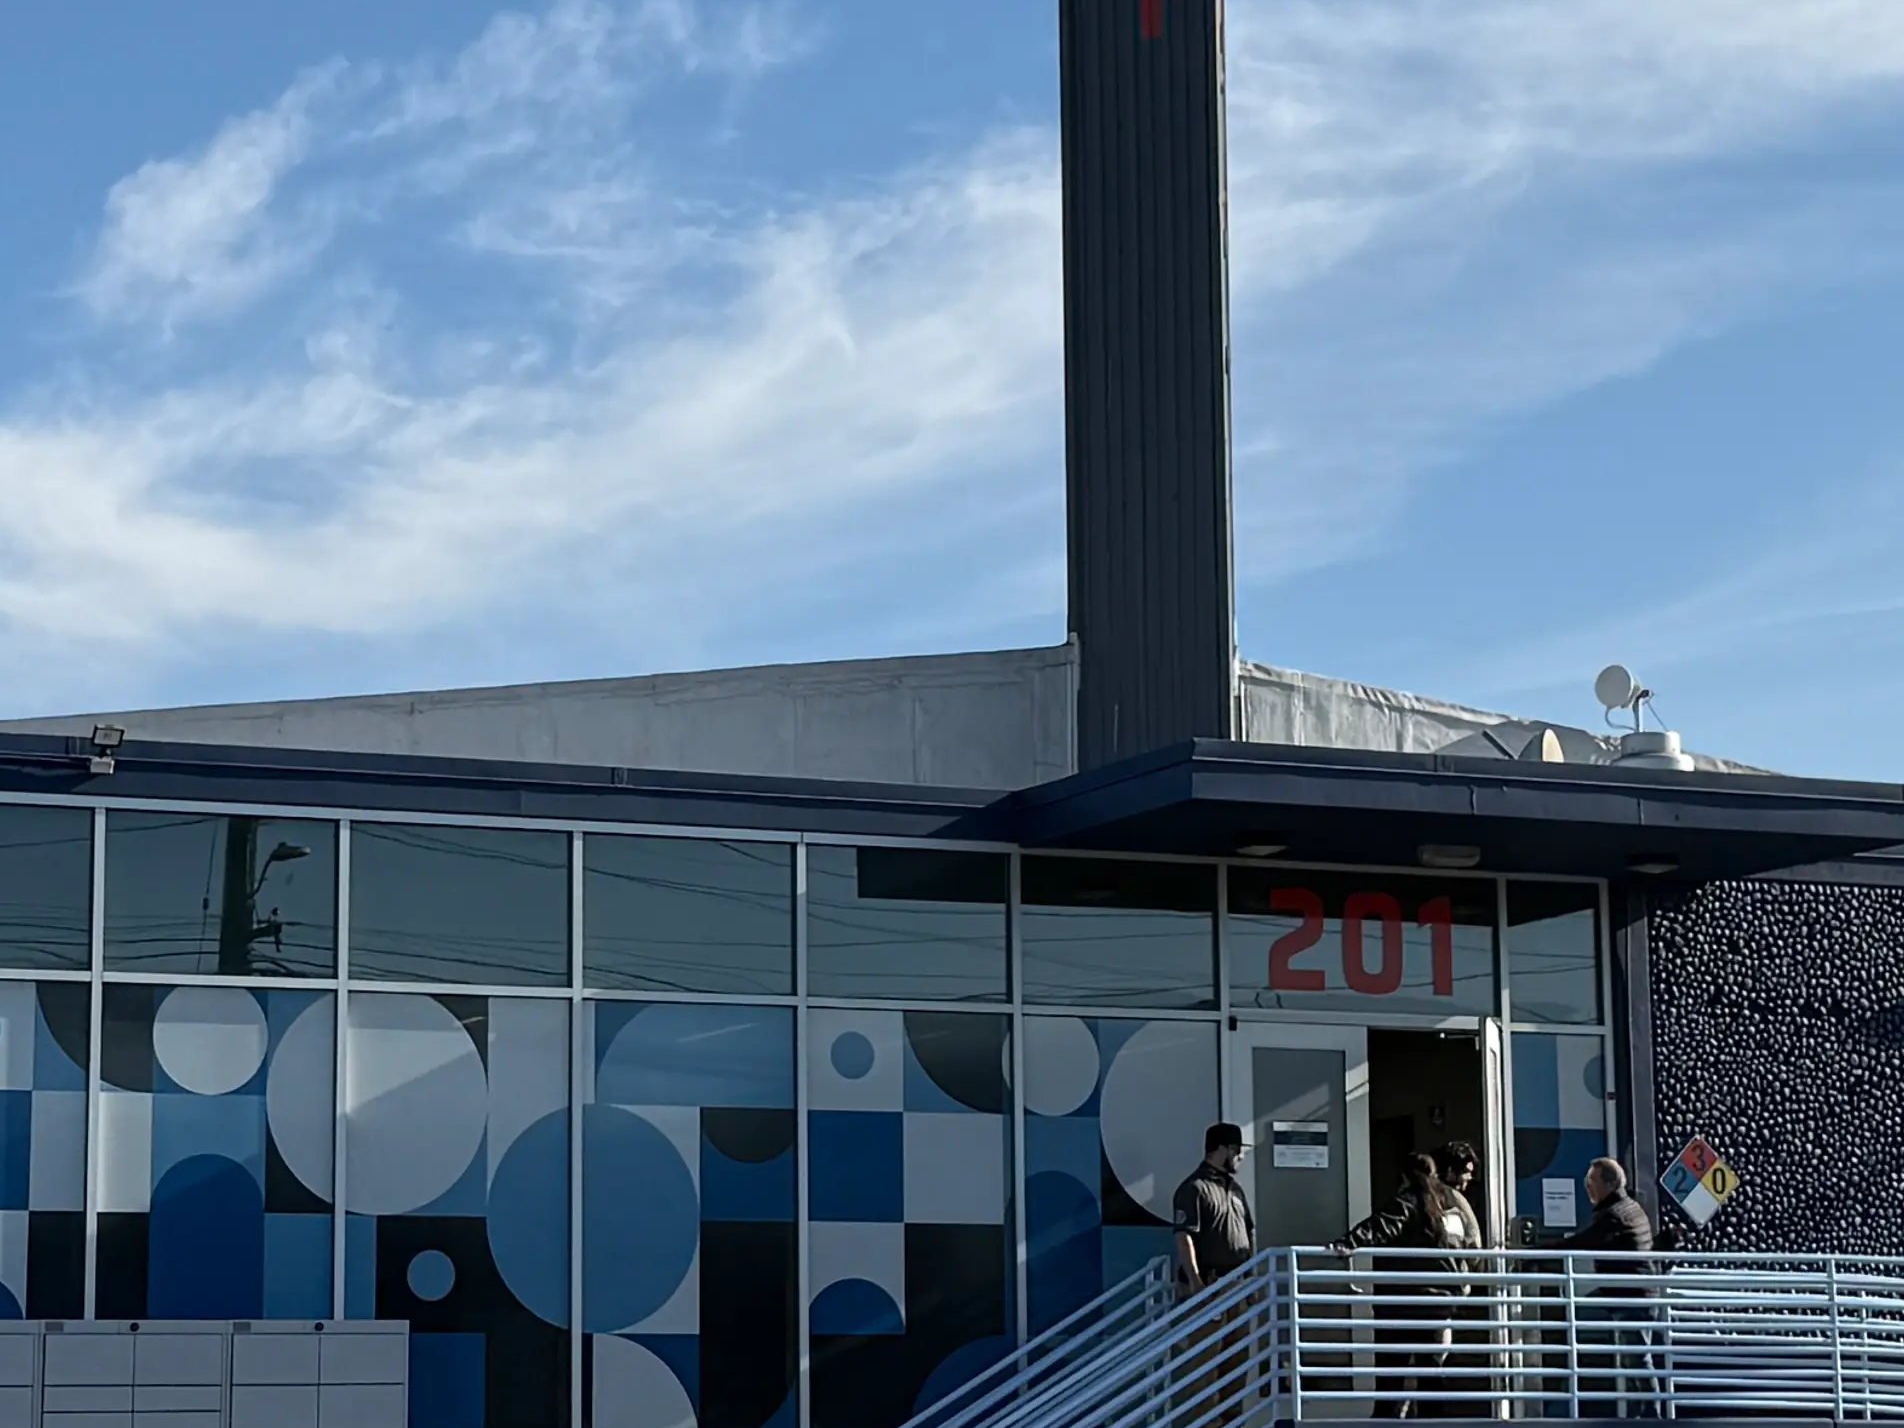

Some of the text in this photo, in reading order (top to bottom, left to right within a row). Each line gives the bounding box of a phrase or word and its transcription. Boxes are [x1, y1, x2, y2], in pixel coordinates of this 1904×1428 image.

[1269, 886, 1453, 996] 201
[1692, 1144, 1705, 1171] 3
[1673, 1167, 1726, 1194] 2 0
